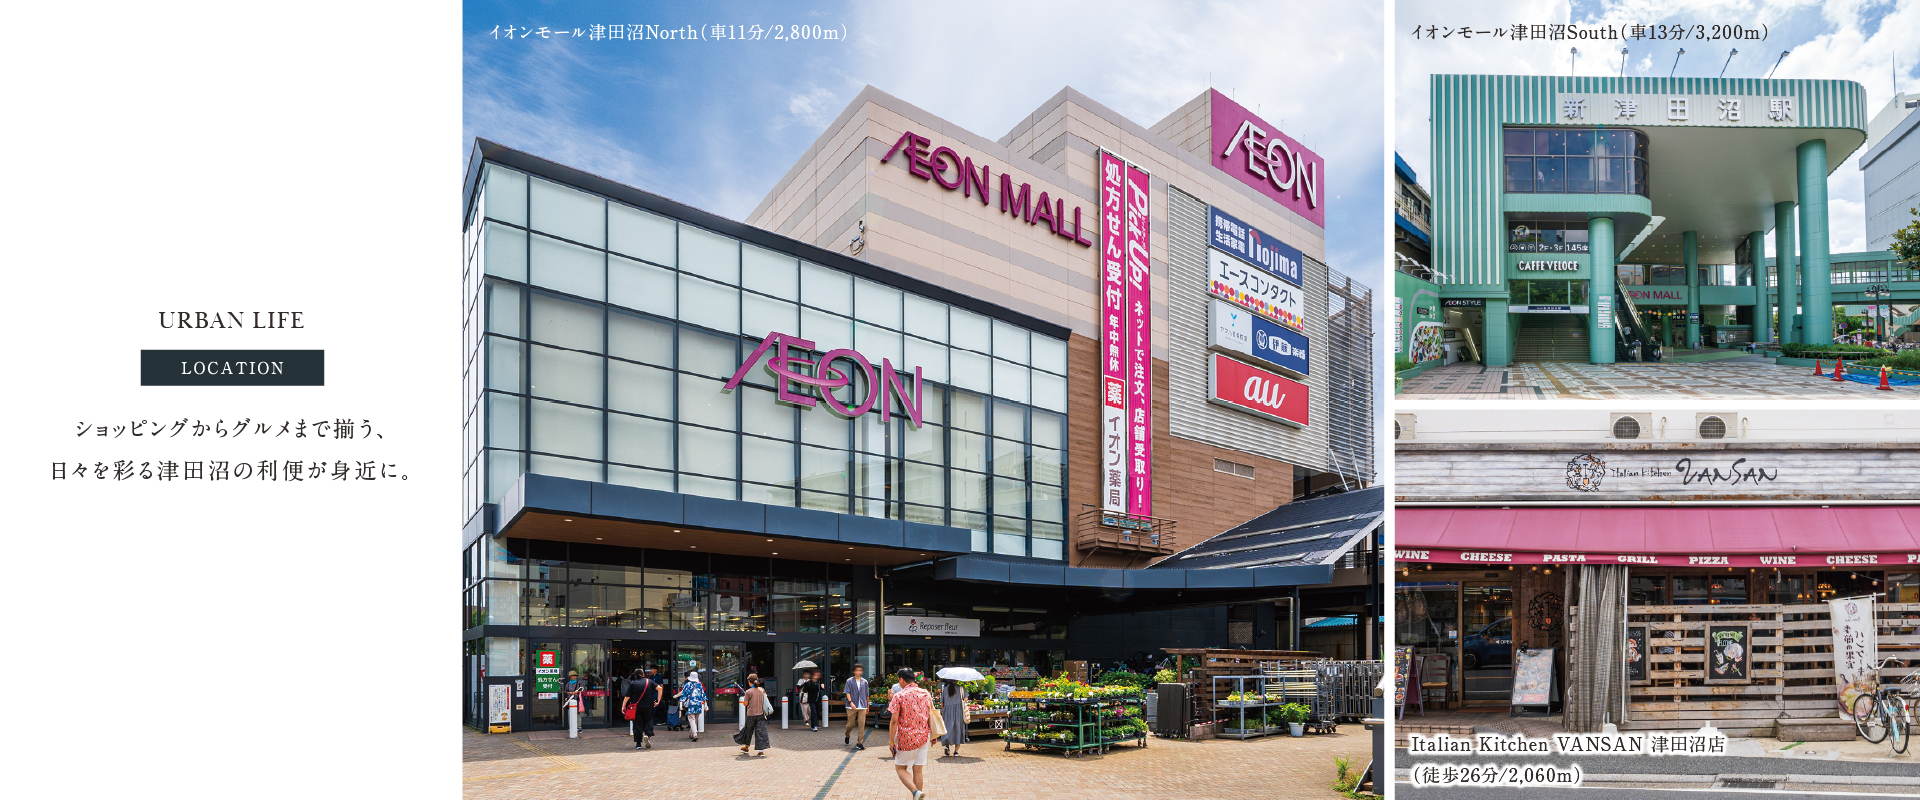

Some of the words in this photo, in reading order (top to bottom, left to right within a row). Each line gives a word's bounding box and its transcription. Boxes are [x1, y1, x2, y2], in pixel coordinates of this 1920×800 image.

[1563, 97, 1794, 121] 新津田沼駅
[1000, 173, 1092, 248] MALL
[1105, 159, 1122, 310] 処方せん受付
[1248, 228, 1298, 280] nojima
[1219, 260, 1297, 308] エースコンタクト
[1546, 260, 1578, 271] VELOCE
[1653, 290, 1683, 300] MALL
[1109, 314, 1120, 373] 年中無休
[1107, 381, 1122, 405] 薬
[1243, 375, 1286, 409] au
[1108, 416, 1122, 507] イオン薬局
[1395, 550, 1430, 560] WINE
[1460, 552, 1513, 562] CHEESE
[1543, 554, 1586, 562] PASTA
[1617, 555, 1658, 564] GRILL
[1689, 556, 1729, 565] PIZZA
[1760, 556, 1796, 565] WINE
[1826, 554, 1878, 564] CHEESE
